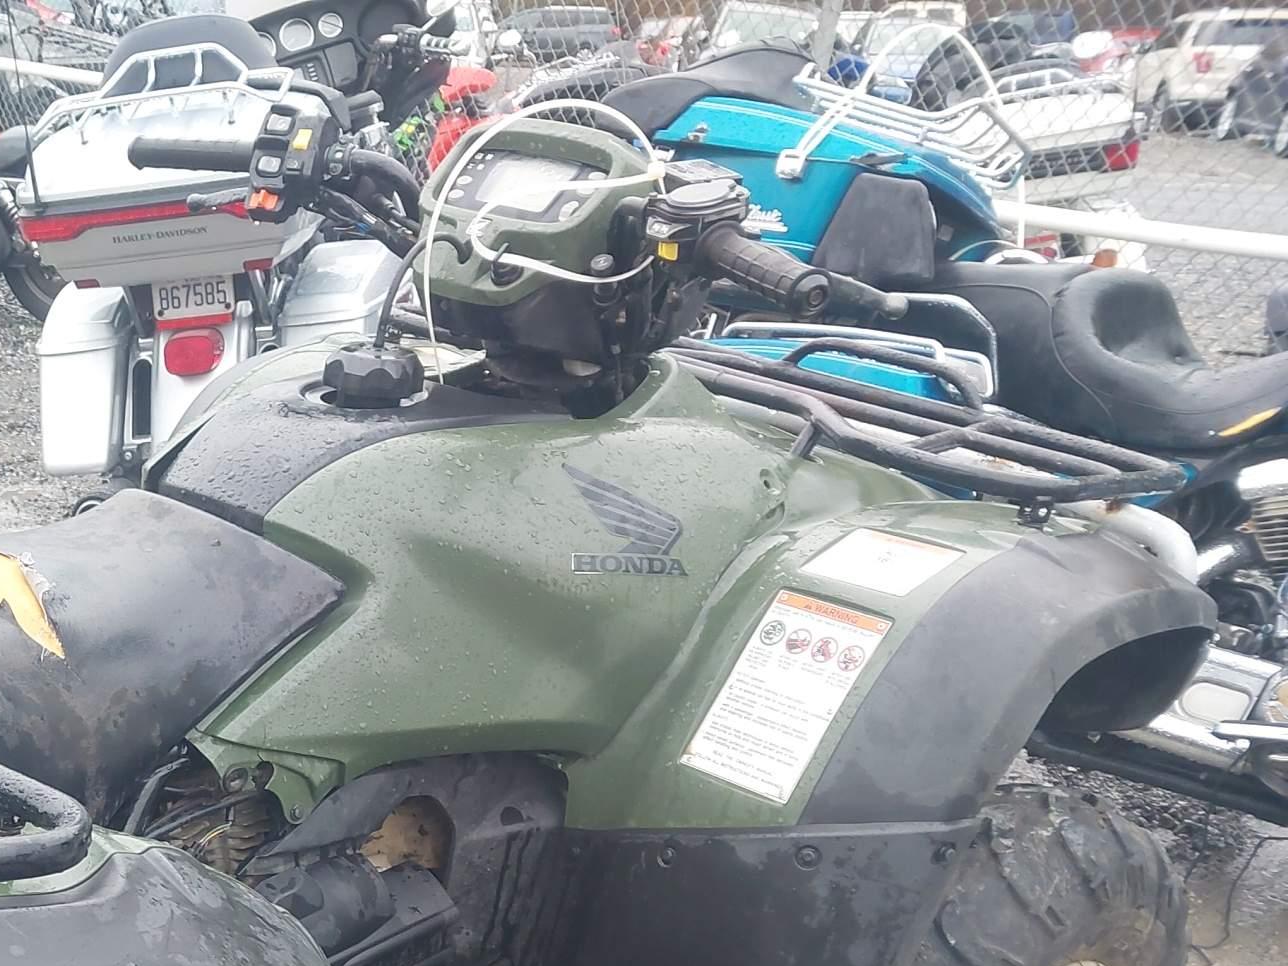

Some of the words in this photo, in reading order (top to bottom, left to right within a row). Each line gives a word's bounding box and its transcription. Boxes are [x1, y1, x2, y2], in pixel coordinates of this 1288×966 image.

[112, 225, 208, 244] HARLEY-DAVIDSON
[158, 280, 228, 312] 867585
[572, 552, 689, 576] HONDA
[814, 602, 860, 624] WARNING
